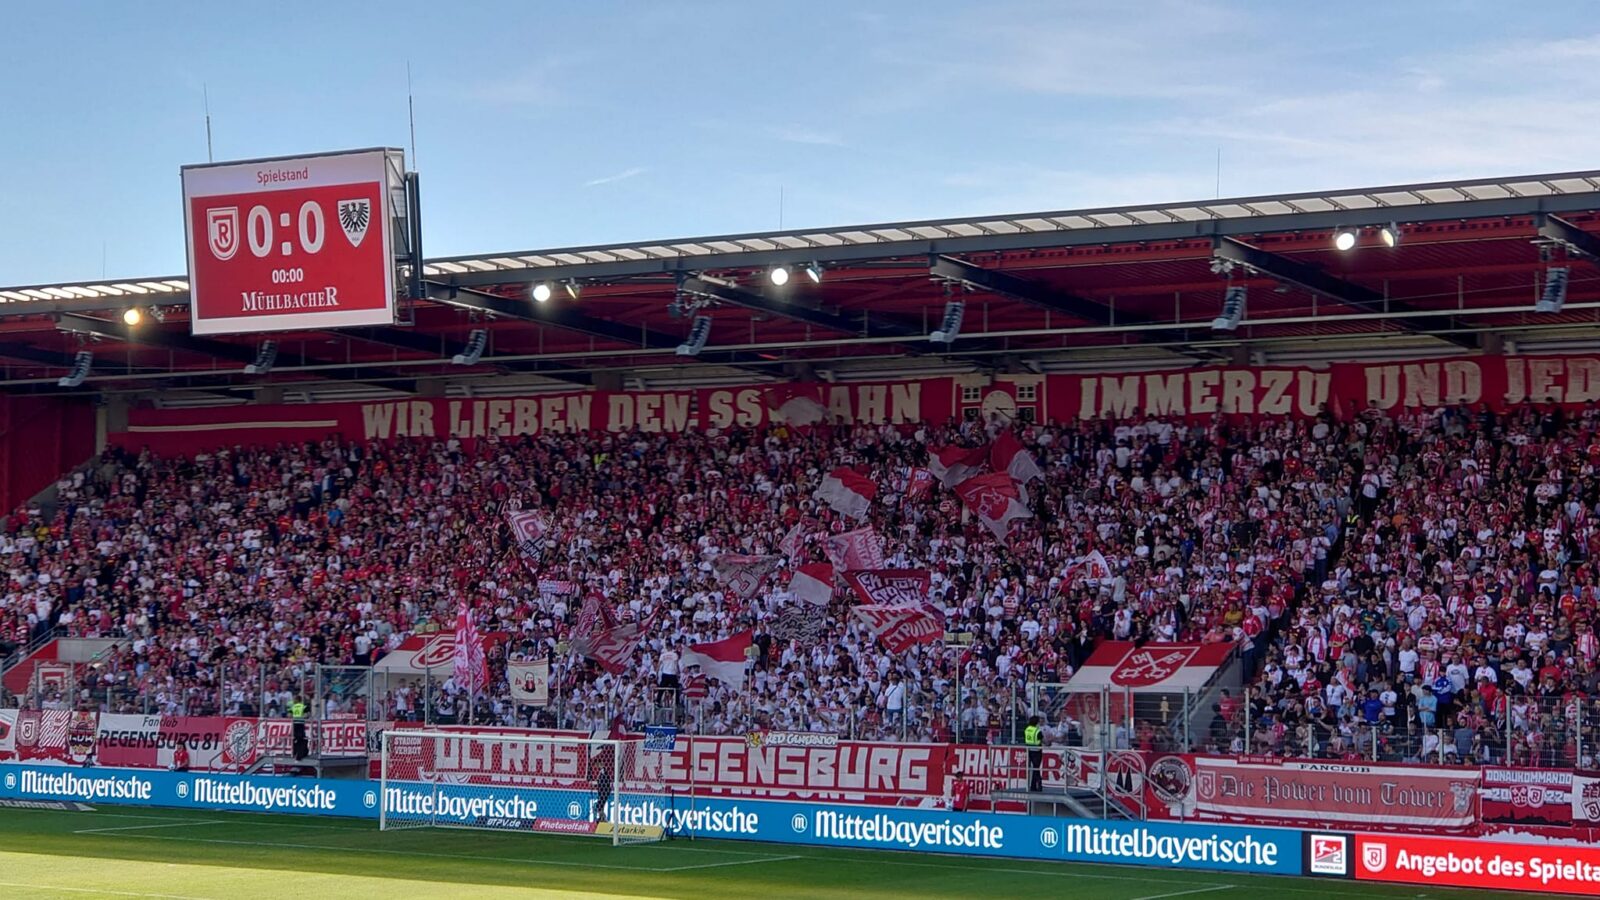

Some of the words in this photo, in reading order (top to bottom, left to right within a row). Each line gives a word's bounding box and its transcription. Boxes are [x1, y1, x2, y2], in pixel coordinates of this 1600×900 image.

[257, 167, 309, 186] Spielstand
[247, 201, 325, 258] 0:0
[272, 268, 304, 284] 00:00
[241, 286, 339, 312] MÜHLBACHER
[1079, 370, 1332, 420] IMMERZU
[1364, 360, 1482, 410] UND
[362, 401, 435, 440] WIR
[451, 395, 592, 439] LIEBEN
[606, 393, 690, 433] DEN
[815, 383, 922, 425] AHN
[142, 716, 178, 728] Fanclub
[100, 730, 200, 751] REGENSBURG
[201, 733, 220, 751] 81
[435, 731, 579, 775] ULTRAS
[634, 740, 931, 791] REGENSBURG
[952, 747, 1009, 775] JAHN
[1300, 763, 1371, 773] FANCLUB
[21, 770, 151, 800] Mittelbayerische
[1220, 774, 1255, 798] Die
[1264, 775, 1326, 804] Power
[1332, 781, 1372, 805] vom
[1380, 782, 1446, 808] Tower
[1485, 769, 1573, 785] DONAUKOMMANDO
[194, 778, 336, 809] Mittelbayerische
[539, 820, 590, 832] Photovoltaik
[816, 810, 1004, 848] Mittelbayerische
[1067, 824, 1278, 866] Mittelbayerische
[1396, 849, 1482, 877] Angebot
[1487, 854, 1524, 877] des
[1529, 857, 1600, 884] Spielta
